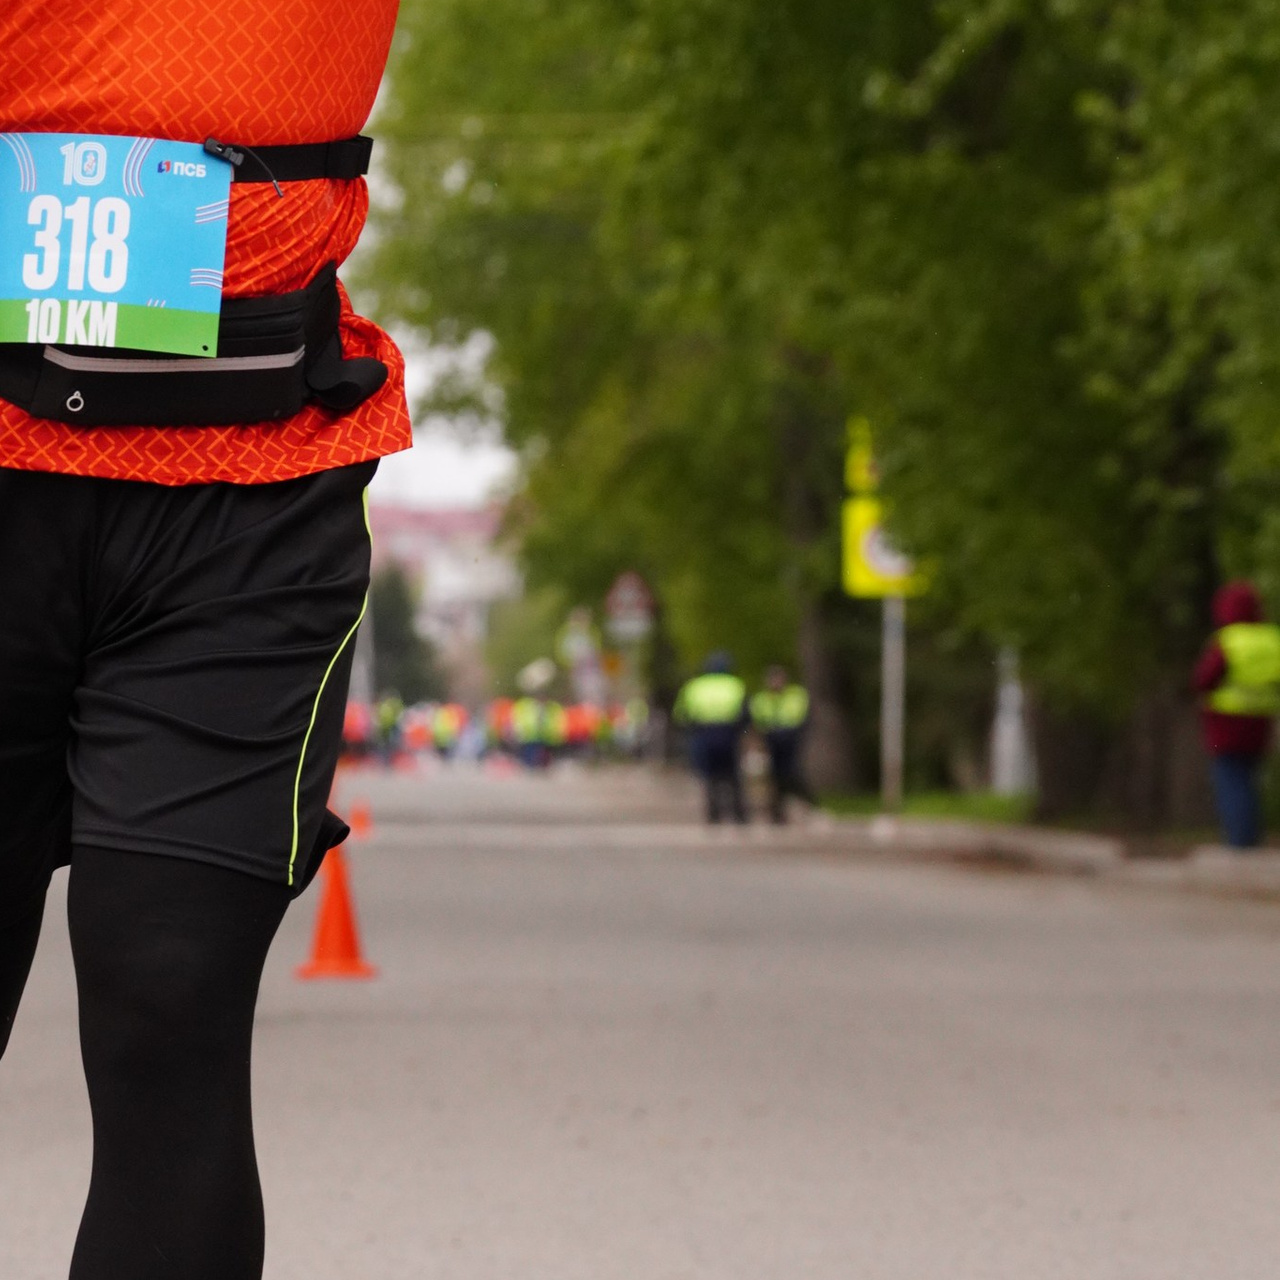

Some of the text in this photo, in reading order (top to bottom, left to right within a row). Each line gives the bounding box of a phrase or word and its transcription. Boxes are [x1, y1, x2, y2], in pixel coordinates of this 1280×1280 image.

[60, 141, 107, 186] 10
[173, 161, 207, 178] ПСБ
[22, 194, 131, 294] 318
[25, 297, 118, 348] 10 KM
